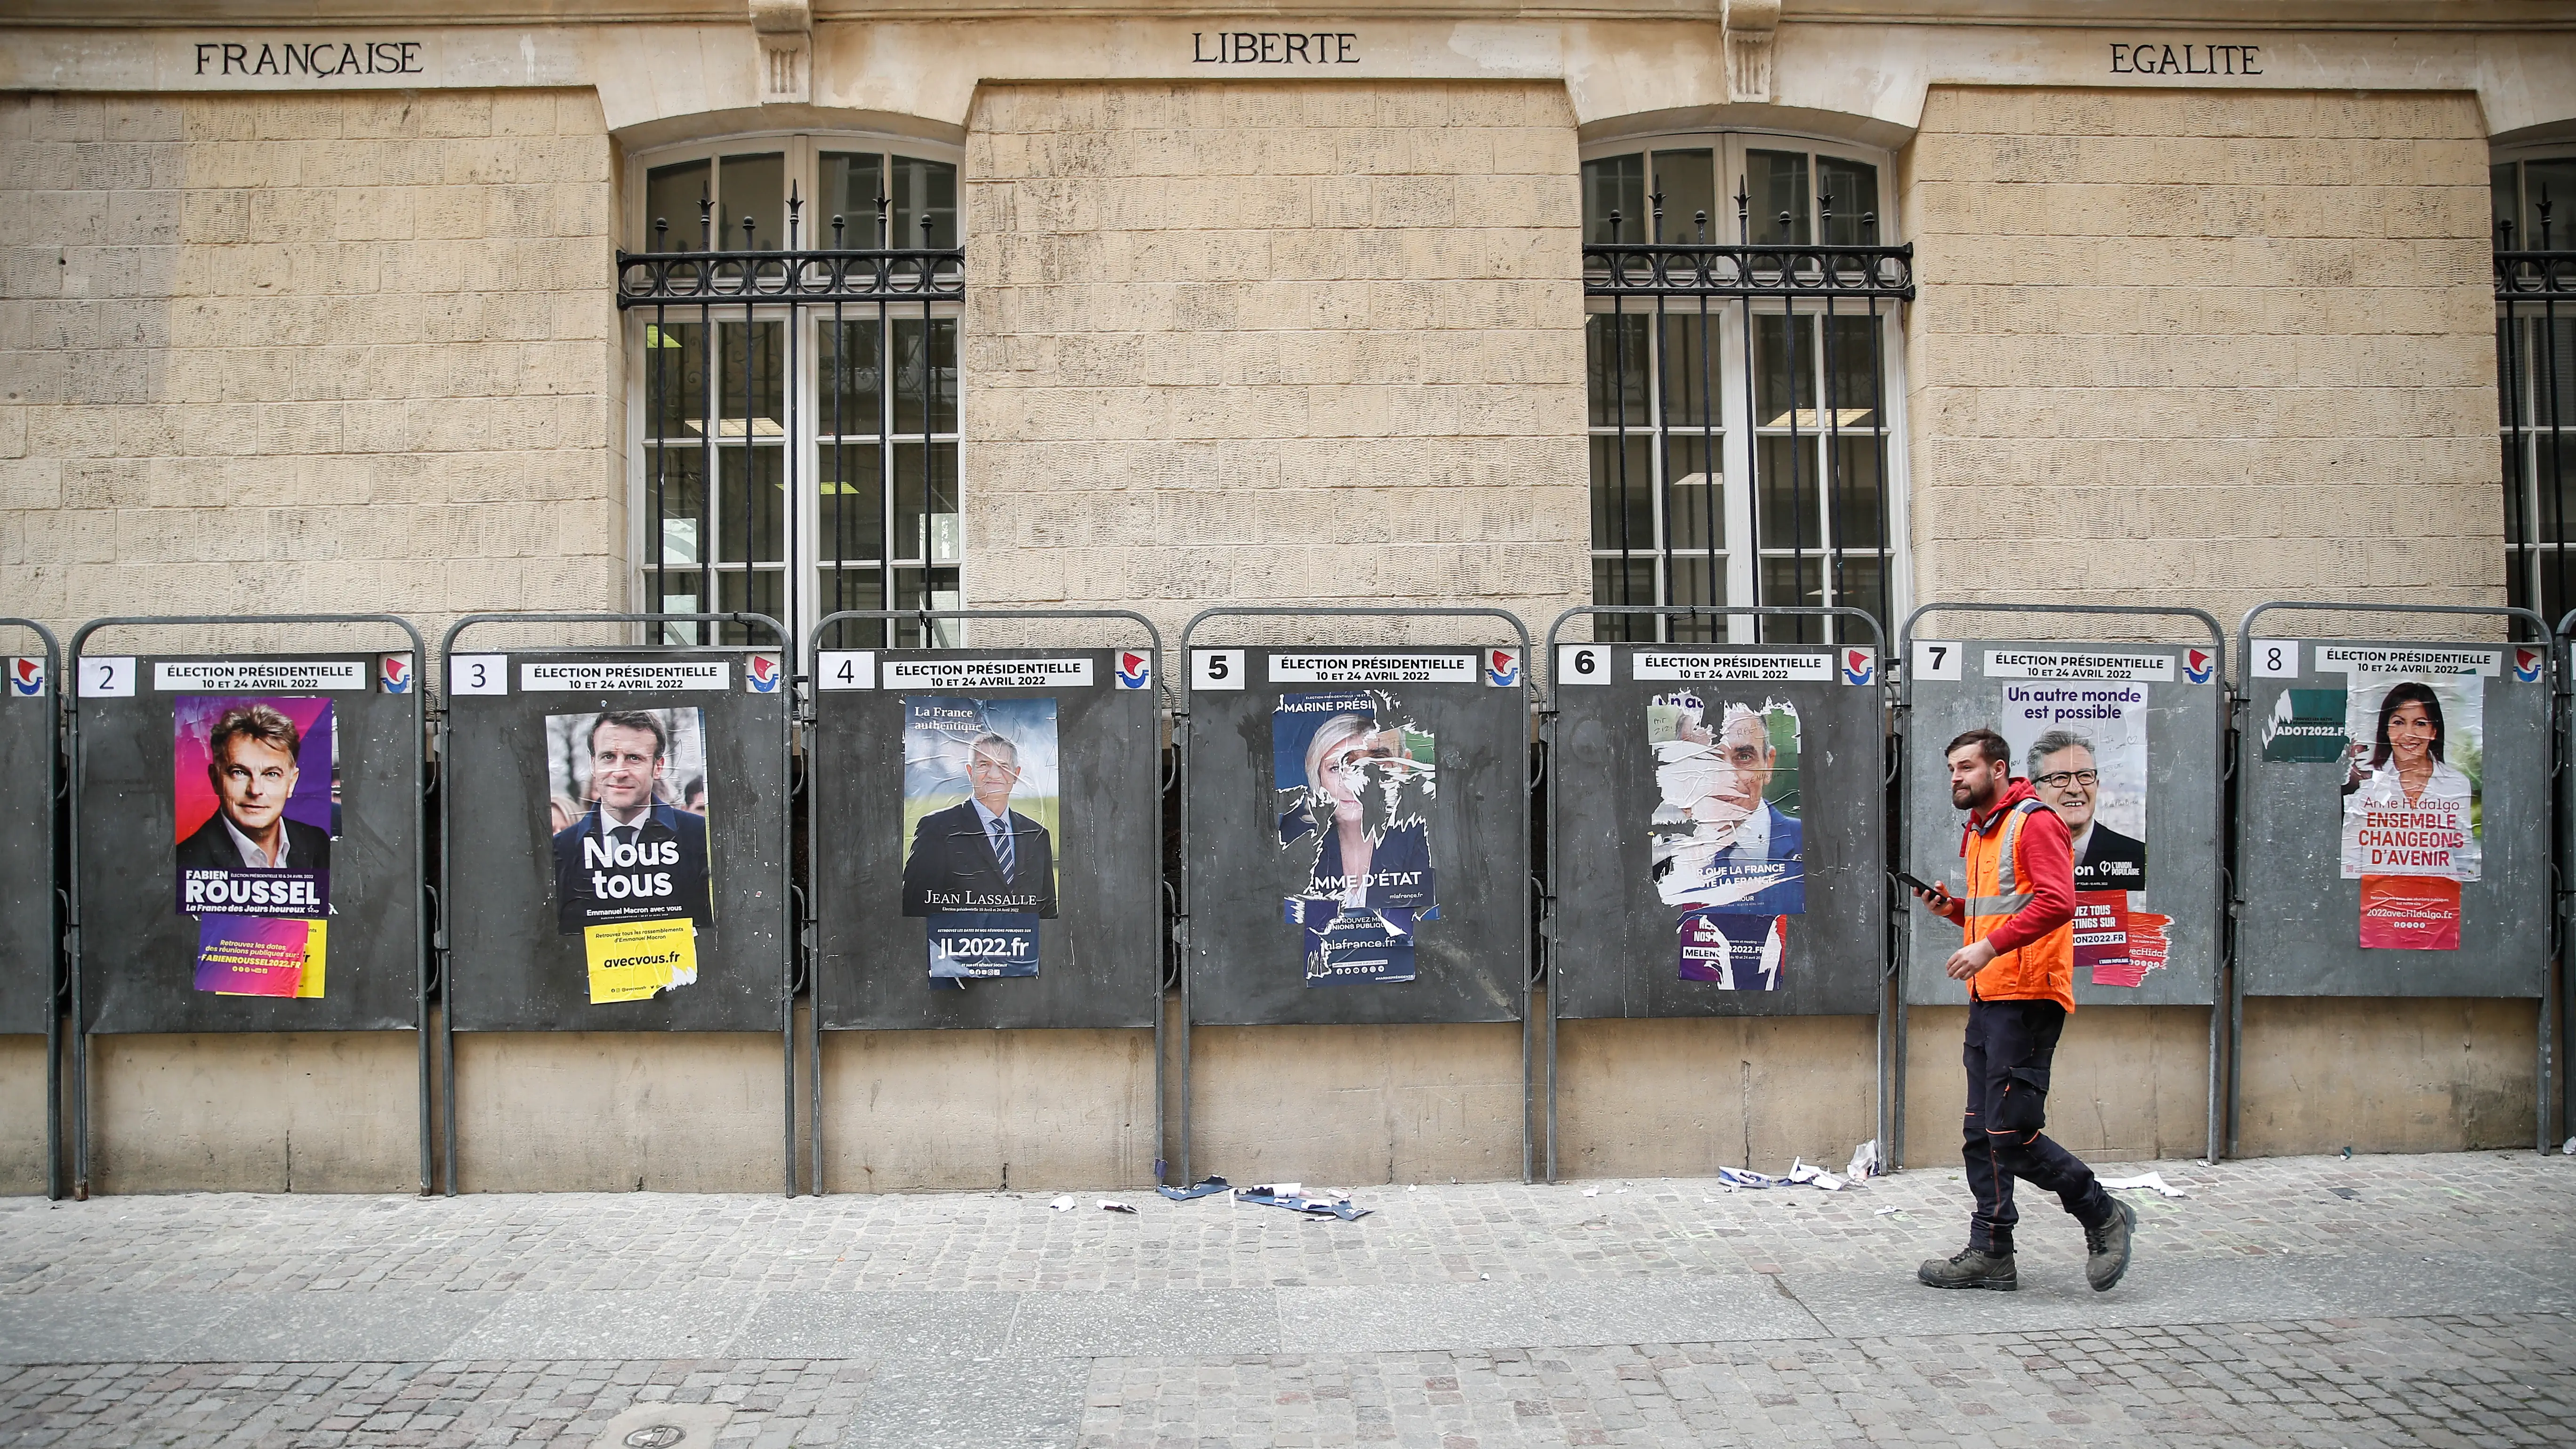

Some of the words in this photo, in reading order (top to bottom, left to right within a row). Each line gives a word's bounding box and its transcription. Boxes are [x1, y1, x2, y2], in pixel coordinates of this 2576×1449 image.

[1192, 33, 1361, 64] LIBERTE
[194, 42, 424, 78] FRANÇAISE
[2109, 43, 2263, 75] EGALITE
[1281, 657, 1348, 669] ÉLECTION
[1352, 657, 1464, 669] PRÉSIDENTIELLE
[1575, 651, 1595, 674] 6
[1646, 655, 1710, 667] ÉLECTION
[1714, 655, 1821, 668] PRÉSIDENTIELLE
[1929, 647, 1947, 670] 7
[1996, 652, 2057, 666] ÉLECTION
[2061, 654, 2164, 668] PRÉSIDENTIELLE
[2267, 647, 2281, 671] 8
[2327, 648, 2386, 661] ÉLECTION
[2391, 650, 2490, 664] PRÉSIDENTIELLE
[167, 664, 234, 677] ÉLECTION
[239, 664, 353, 677] PRÉSIDENTIELLE
[534, 665, 601, 678] ÉLECTION
[606, 664, 717, 677] PRÉSIDENTIELLE
[837, 660, 854, 684] 4
[896, 664, 963, 676] ÉLECTION
[967, 661, 1081, 675] PRÉSIDENTIELLE
[1208, 655, 1229, 679] 5
[1679, 670, 1690, 678] 10
[1709, 670, 1722, 678] 24
[1726, 670, 1759, 678] AVRIL
[1762, 670, 1788, 679] 2022
[2027, 668, 2038, 676] 10
[2056, 668, 2069, 677] 24
[2071, 669, 2104, 678] AVRIL
[2107, 670, 2132, 678] 2022
[2358, 663, 2368, 671] 10
[2385, 664, 2398, 672] 24
[2400, 665, 2432, 673] AVRIL
[2435, 666, 2459, 674] 2022
[99, 666, 114, 690] 2
[471, 664, 487, 688] 3
[931, 678, 943, 686] 10
[962, 677, 976, 686] 24
[979, 676, 1015, 686] AVRIL
[1018, 676, 1046, 685] 2022
[1316, 671, 1328, 680] 10
[1347, 671, 1361, 680] 24
[1364, 671, 1399, 680] AVRIL
[1402, 671, 1430, 680] 2022
[202, 680, 214, 688] 10
[234, 679, 248, 688] 24
[252, 679, 287, 688] AVRIL
[291, 679, 318, 688] 2022
[569, 681, 581, 689] 10
[600, 680, 614, 689] 24
[618, 679, 653, 689] AVRIL
[656, 679, 684, 688] 2022
[2008, 686, 2029, 701] Un
[2033, 687, 2077, 701] autre
[2081, 687, 2141, 702] monde
[915, 707, 930, 716] La
[933, 707, 973, 717] France
[1284, 701, 1334, 713] MARINE
[2024, 706, 2048, 719] est
[2054, 704, 2122, 723] possible
[914, 720, 982, 733] authentique
[2276, 726, 2344, 736] ADOT2022.F
[2403, 797, 2460, 813] Hidalgo
[2367, 812, 2456, 829] ENSEMBLE
[2359, 830, 2464, 848] CHANGEONS
[583, 835, 680, 869] Nous
[2372, 849, 2450, 867] D'AVENIR
[185, 870, 228, 880] FABIEN
[1705, 866, 1728, 877] QUE
[1730, 866, 1744, 875] LA
[1744, 863, 1786, 874] FRANCE
[2074, 865, 2094, 876] on
[592, 870, 673, 899] tous
[1314, 875, 1357, 890] MME
[1362, 869, 1422, 887] D'ÉTAT
[185, 880, 321, 904] ROUSSEL
[924, 890, 960, 904] JEAN
[966, 890, 1037, 905] LASSALLE
[587, 907, 622, 916] Emmanuel
[2089, 905, 2110, 915] TOUS
[2367, 909, 2453, 920] 2022avecHidalgo.fr
[2100, 917, 2116, 927] SUR
[219, 945, 249, 954] réunions
[250, 949, 284, 958] publiques
[220, 940, 254, 948] Retrouvez
[938, 937, 1030, 959] JL2022.fr
[201, 954, 301, 969] FABIENROUSSEL2022.FR
[604, 951, 680, 968] avecvous.fr
